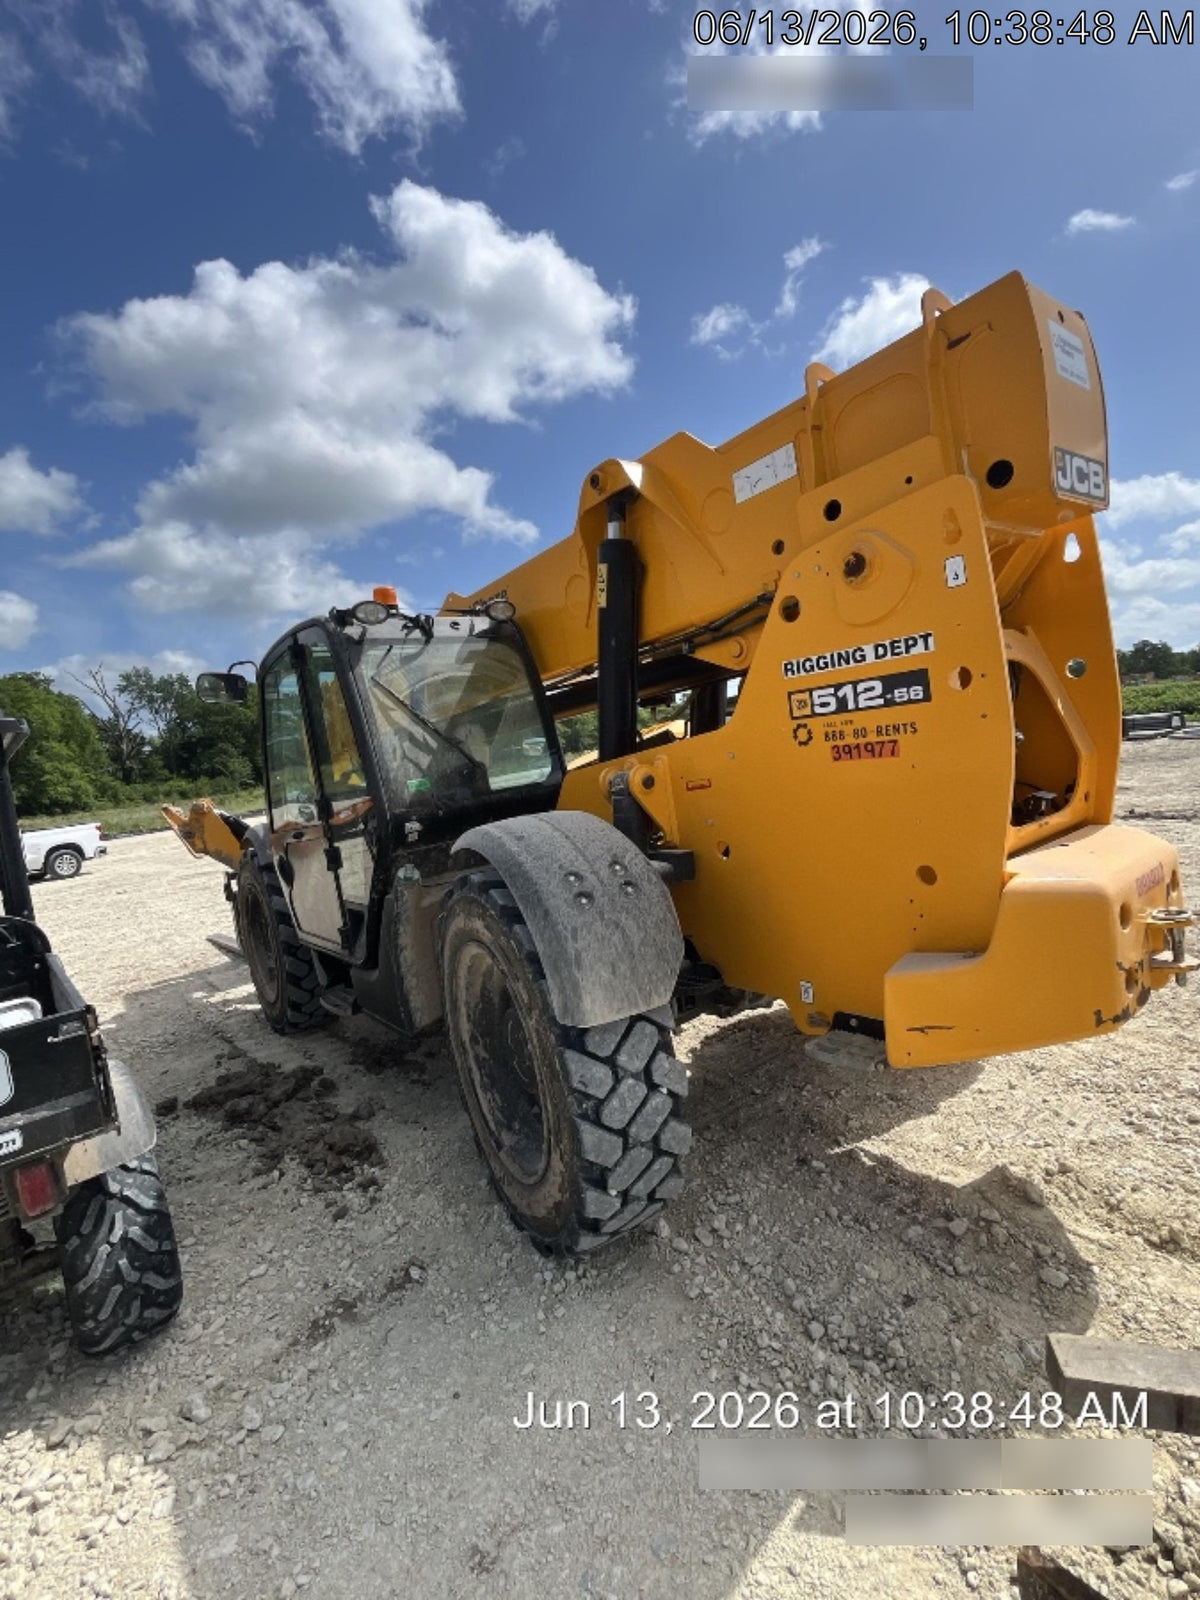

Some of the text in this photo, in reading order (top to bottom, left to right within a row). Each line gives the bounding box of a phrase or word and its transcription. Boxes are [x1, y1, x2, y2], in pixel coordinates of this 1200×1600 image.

[1057, 453, 1105, 498] JCB
[783, 632, 933, 678] RIGGING DEPT
[831, 739, 899, 762] 391977
